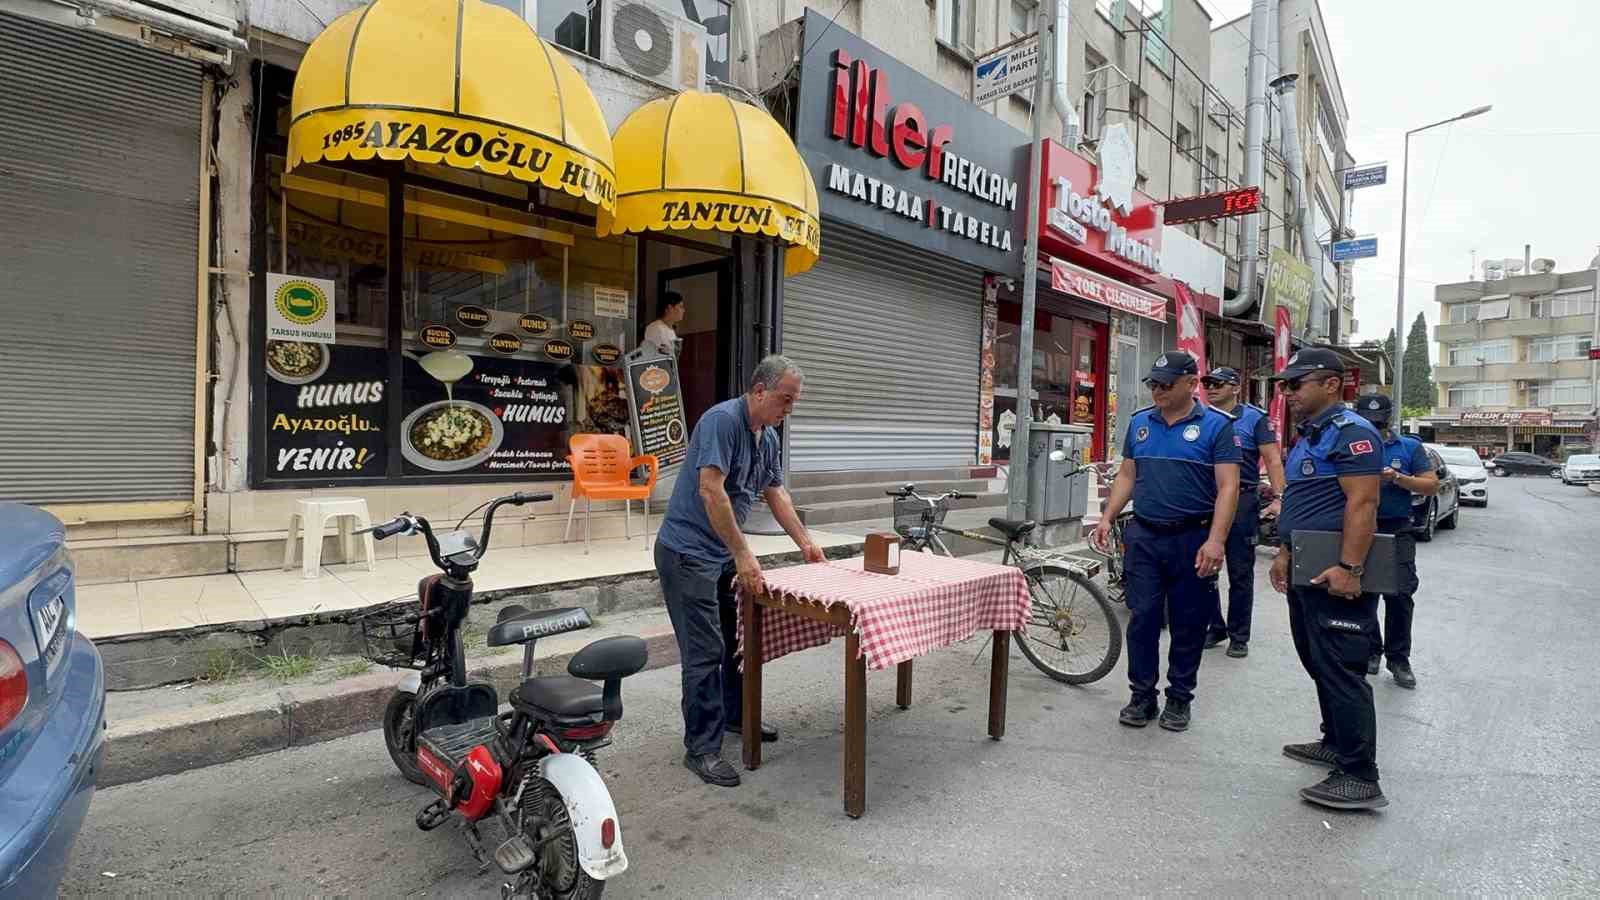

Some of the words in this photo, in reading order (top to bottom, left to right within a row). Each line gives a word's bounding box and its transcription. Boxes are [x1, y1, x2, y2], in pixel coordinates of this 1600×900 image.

[322, 121, 365, 149] 1985
[359, 121, 552, 174] AYAZOĞLU
[560, 160, 615, 206] HUMU
[943, 151, 1018, 211] REKLAM
[662, 201, 772, 226] TANTUNİ
[829, 163, 924, 222] MATBAA
[941, 205, 1012, 251] TABELA
[1058, 176, 1111, 231] Tosto
[1076, 277, 1103, 298] TOST
[271, 328, 300, 337] TARSUS
[301, 329, 332, 339] HUMUSU
[298, 381, 385, 408] HUMUS
[502, 403, 565, 424] HUMUS
[276, 440, 368, 472] YENİR!
[522, 616, 583, 638] PEUGEOT
